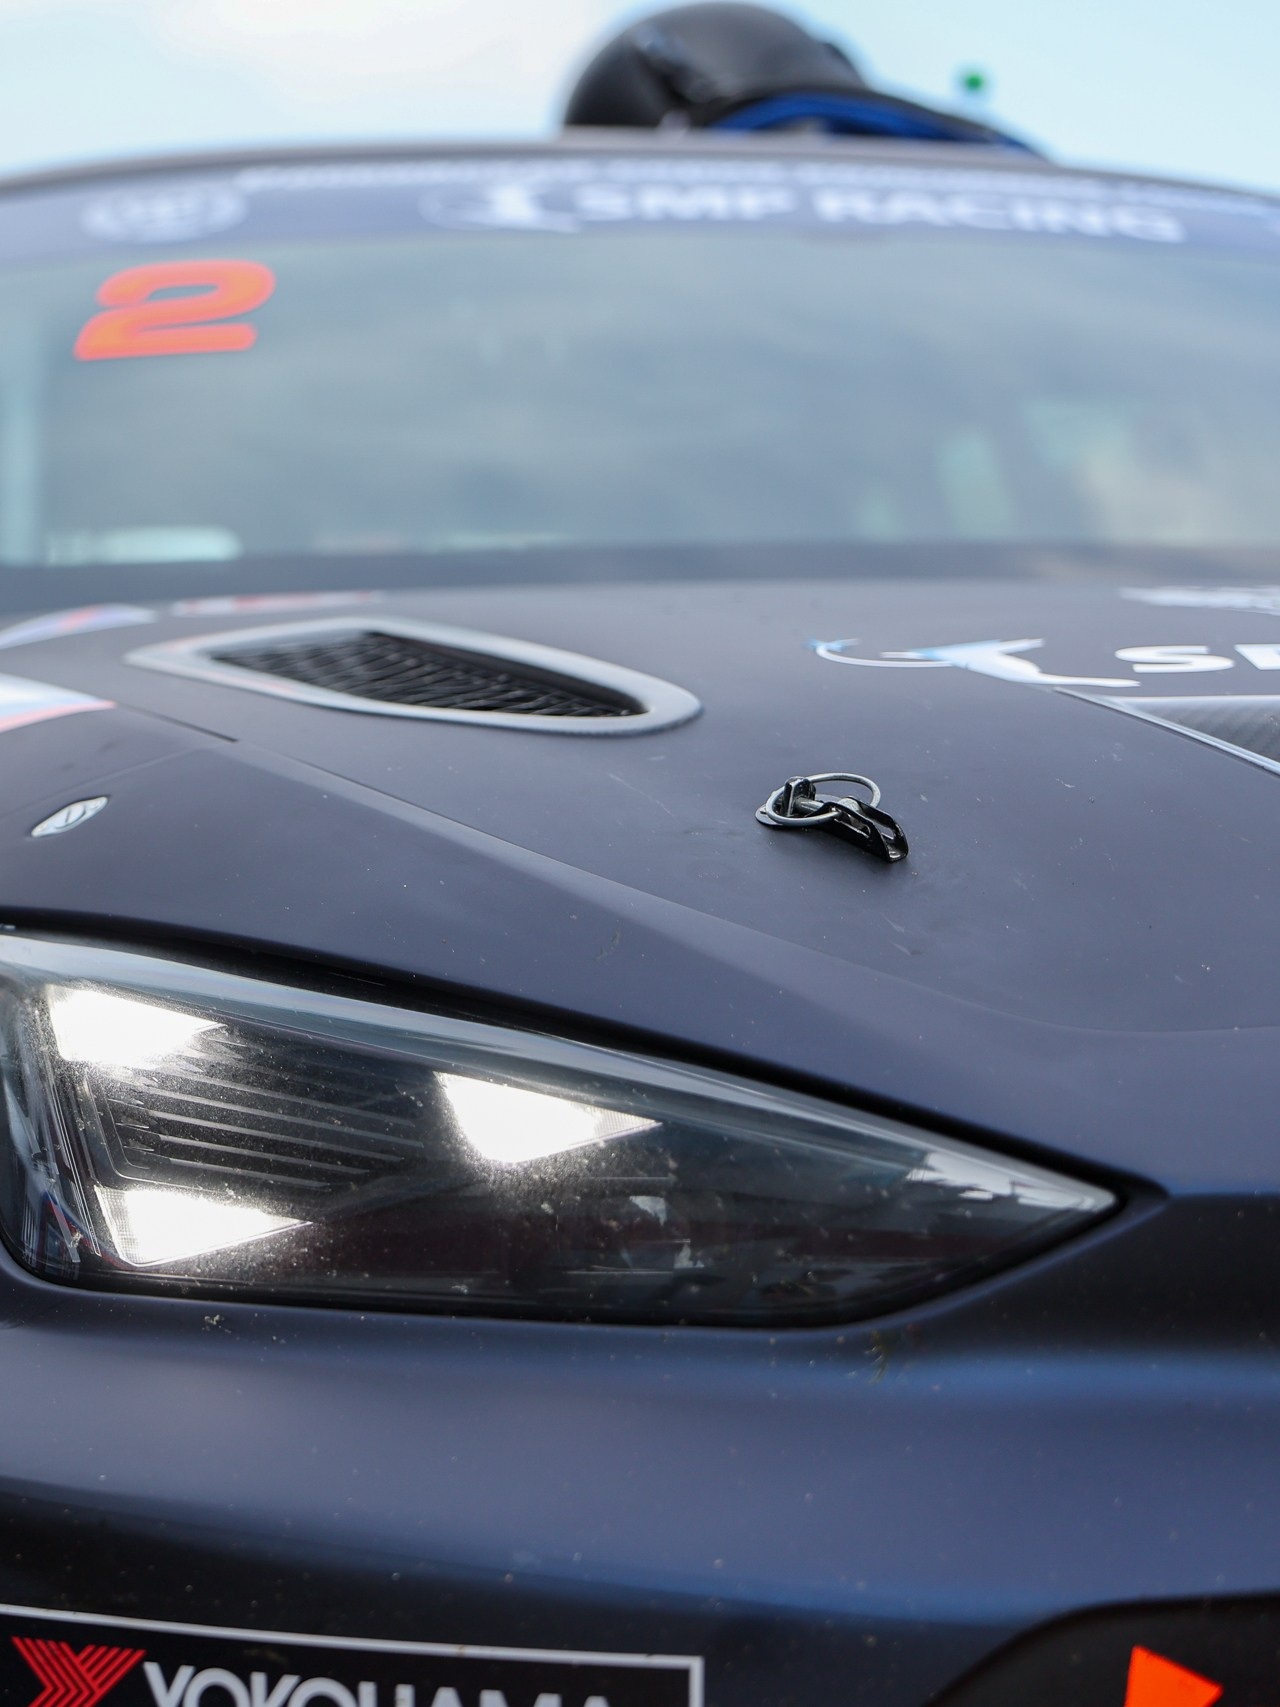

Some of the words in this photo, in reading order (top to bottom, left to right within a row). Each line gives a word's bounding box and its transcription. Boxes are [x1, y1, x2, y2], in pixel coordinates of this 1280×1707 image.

[573, 182, 795, 222] SMP
[813, 187, 1187, 243] RACING
[73, 259, 277, 361] 2
